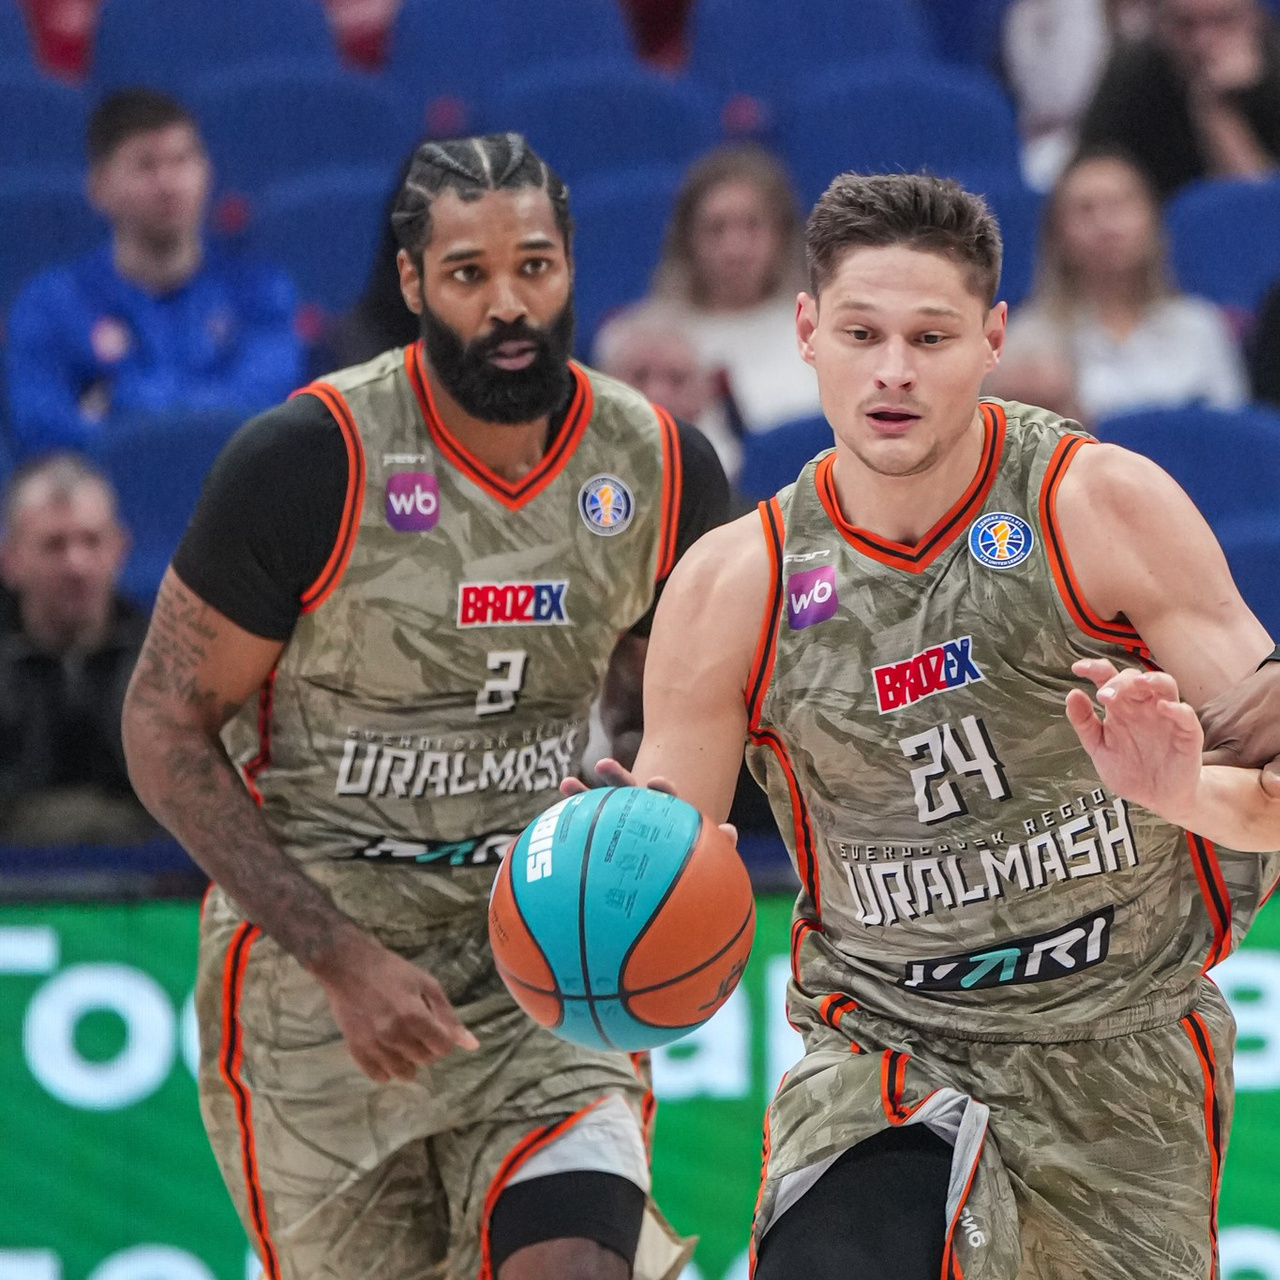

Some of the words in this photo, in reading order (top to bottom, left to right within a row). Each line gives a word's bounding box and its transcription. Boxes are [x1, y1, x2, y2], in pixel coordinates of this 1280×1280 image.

[389, 484, 436, 515] wb
[459, 583, 567, 626] BROZEX
[791, 578, 833, 615] wb
[475, 650, 528, 716] 2
[874, 637, 982, 713] BROZEX
[898, 715, 1006, 823] 24
[1023, 787, 1105, 835] REGIO
[842, 798, 1138, 926] URALMASH
